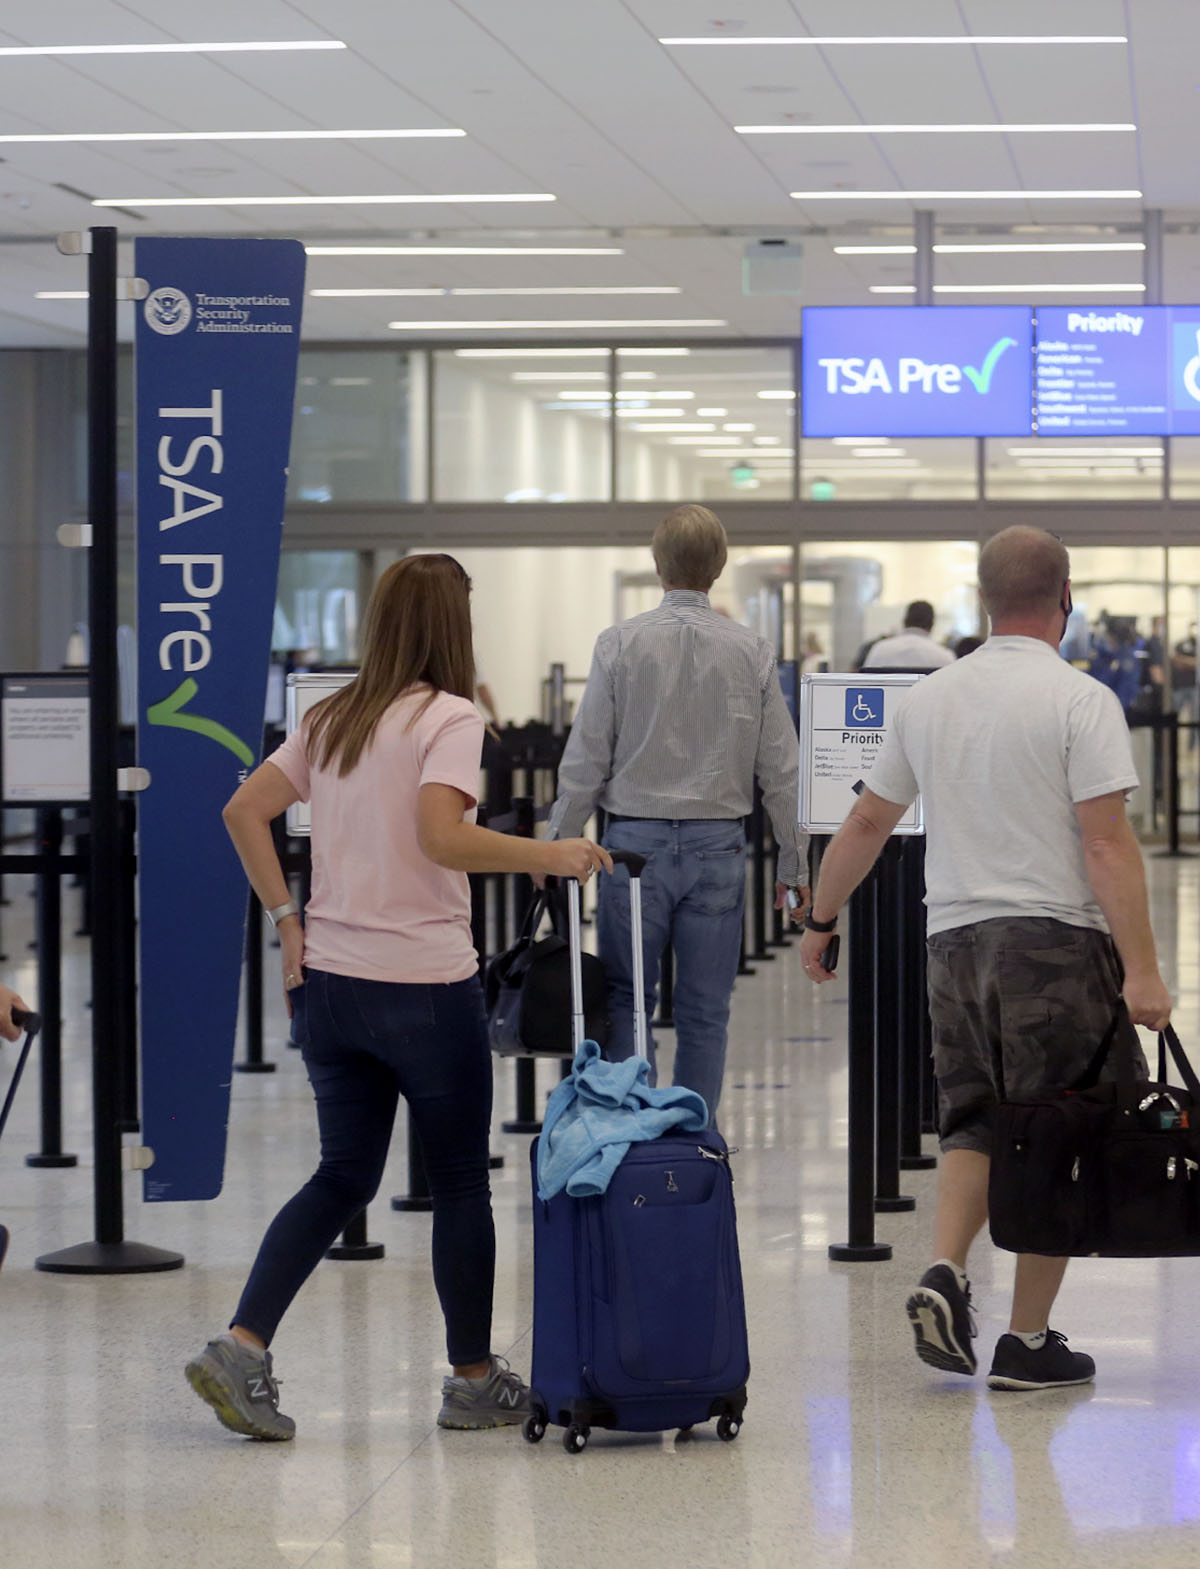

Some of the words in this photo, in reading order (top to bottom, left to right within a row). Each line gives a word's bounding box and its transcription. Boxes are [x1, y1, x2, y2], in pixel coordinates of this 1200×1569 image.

[195, 293, 291, 310] Transportation
[195, 321, 293, 333] Administration
[196, 308, 250, 323] Security
[1067, 312, 1144, 336] Priority
[818, 358, 892, 394] TSA
[899, 358, 962, 394] Pre
[158, 389, 223, 532] TSA
[159, 554, 223, 672] Pre
